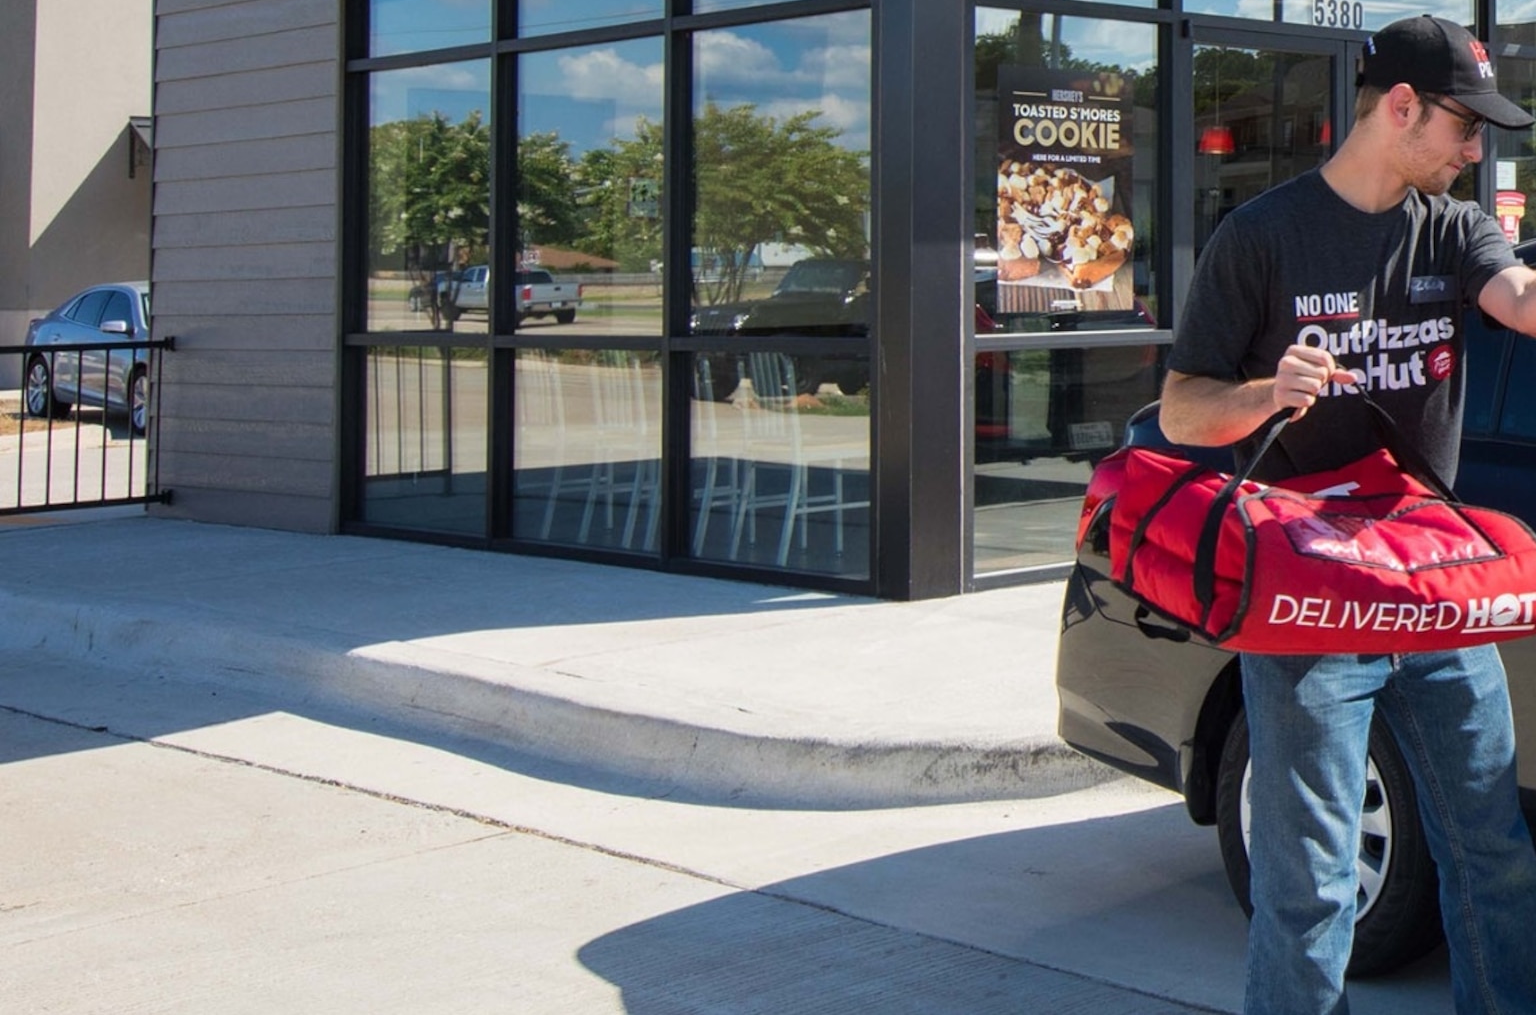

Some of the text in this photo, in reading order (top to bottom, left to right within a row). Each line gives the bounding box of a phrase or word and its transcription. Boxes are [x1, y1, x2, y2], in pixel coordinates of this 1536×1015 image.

[1013, 103, 1121, 122] TOASTED S'MORES
[1013, 118, 1120, 150] COOKIE
[1295, 292, 1359, 317] NO ONE
[1297, 316, 1455, 356] OutPizzas
[1268, 594, 1462, 632] DELIVERED
